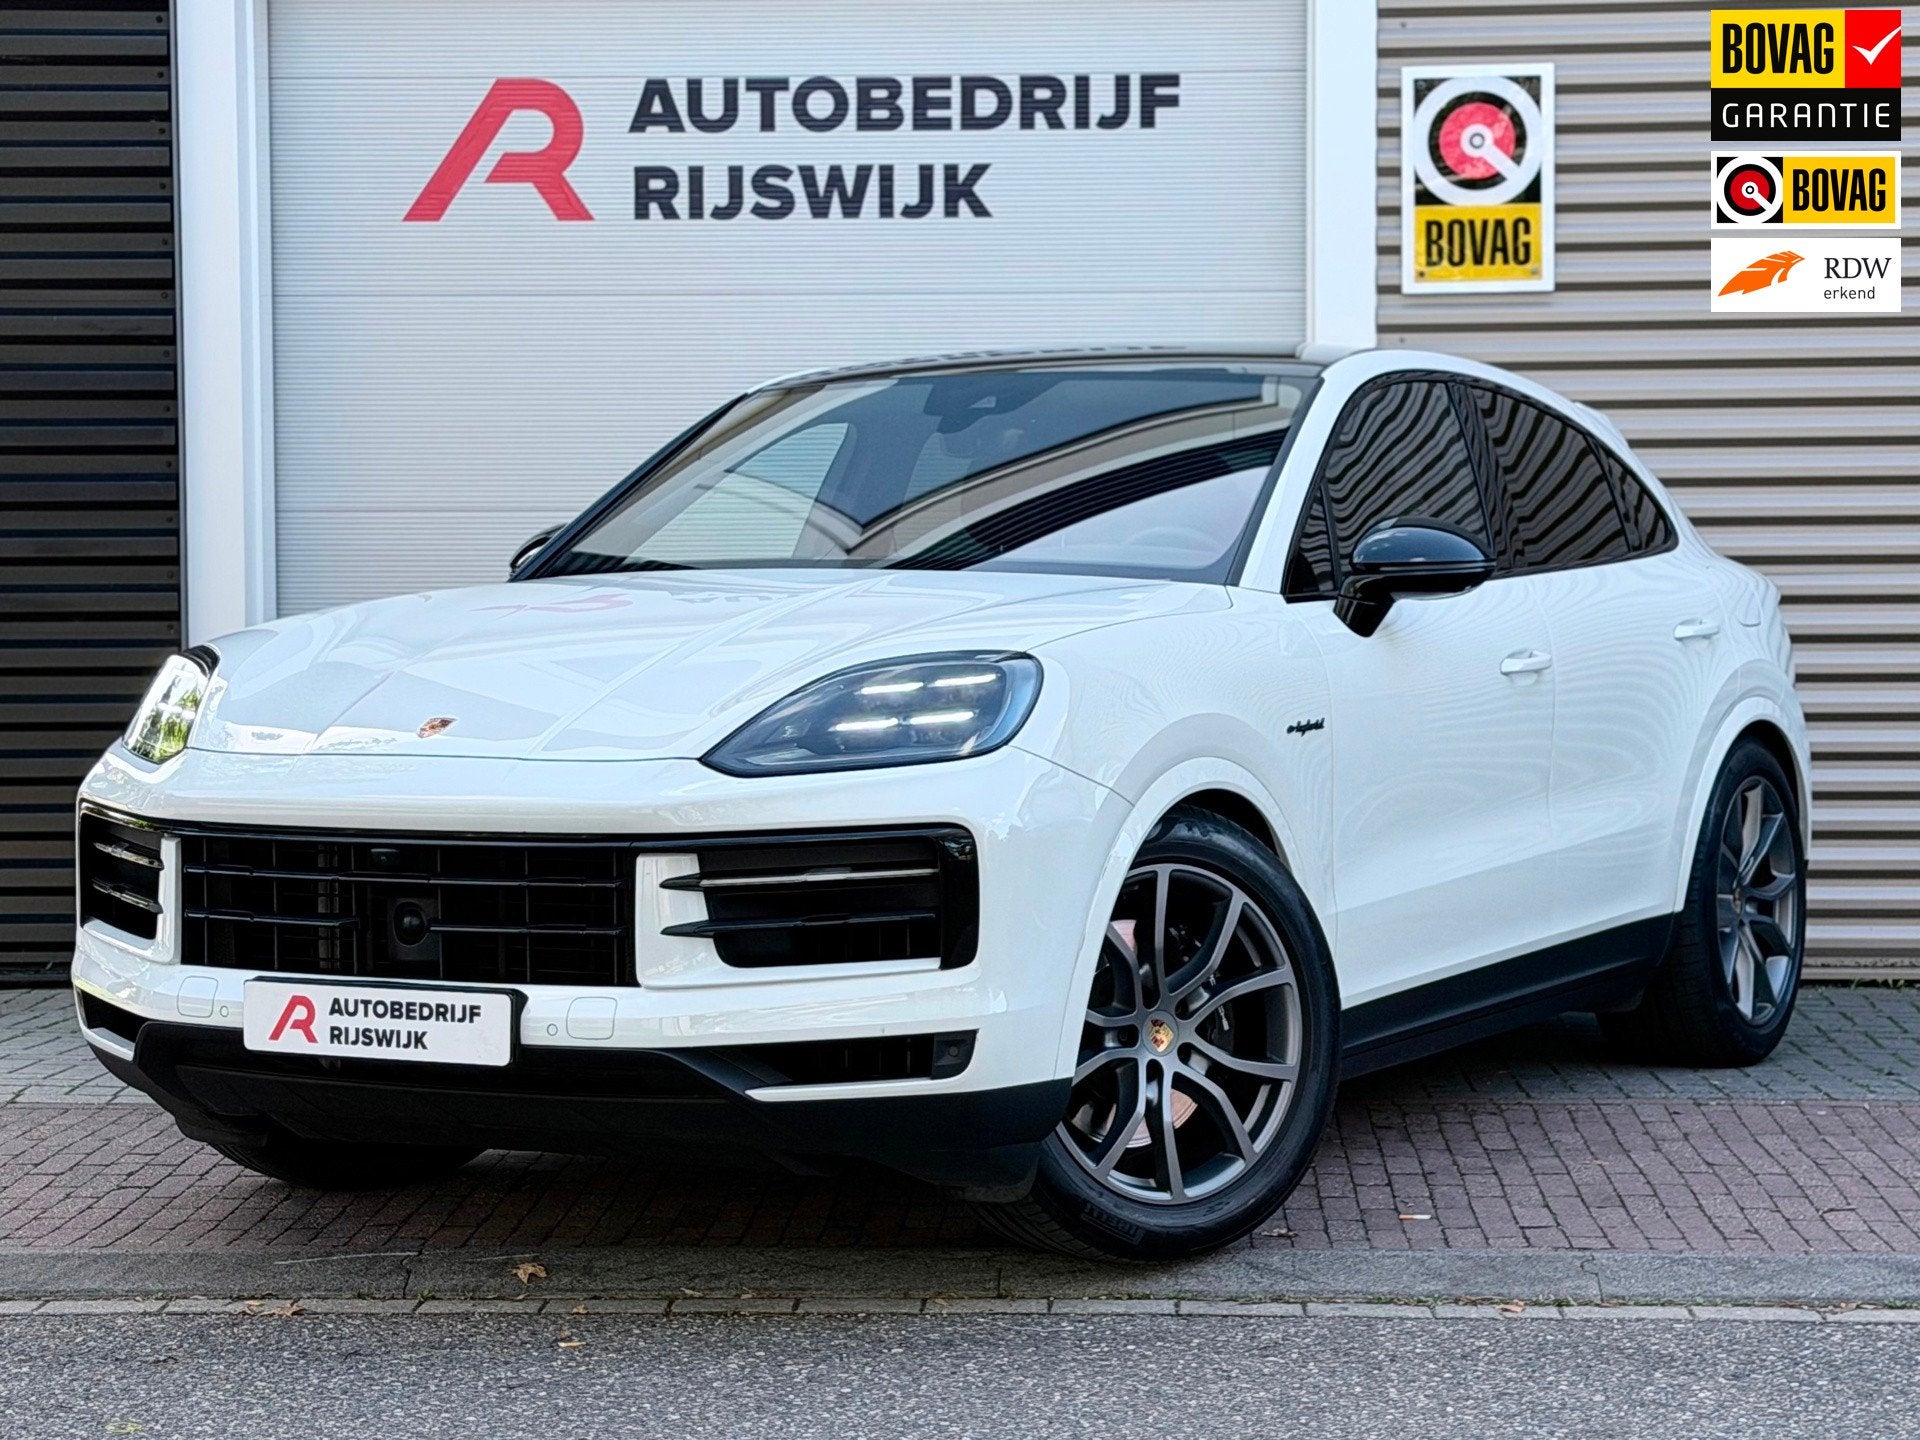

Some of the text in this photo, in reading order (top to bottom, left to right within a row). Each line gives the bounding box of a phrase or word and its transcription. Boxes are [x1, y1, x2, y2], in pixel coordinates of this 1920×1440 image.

[628, 74, 1181, 133] AUTOBEDRIJF
[633, 163, 993, 221] RIJSWIJK
[1426, 217, 1531, 266] BOVAG
[328, 997, 482, 1023] AUTOBEDRIJF
[329, 1026, 429, 1050] RIJSWIJK
